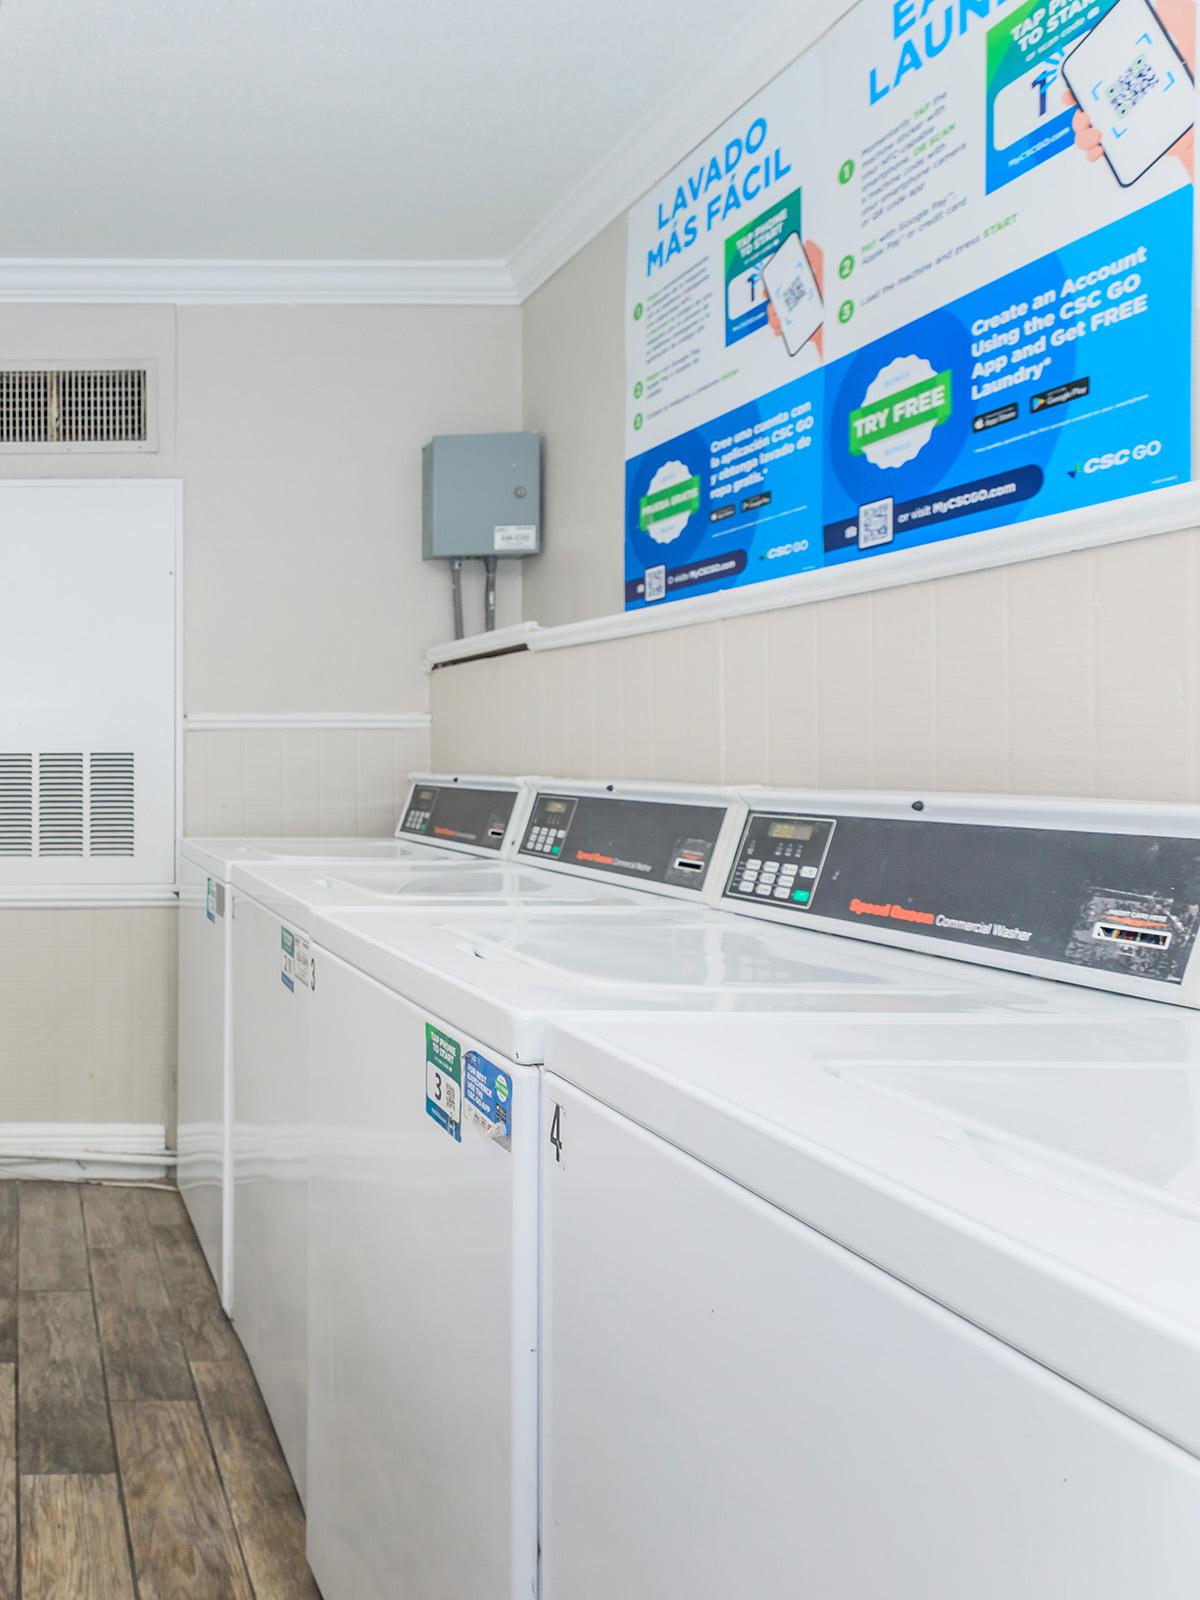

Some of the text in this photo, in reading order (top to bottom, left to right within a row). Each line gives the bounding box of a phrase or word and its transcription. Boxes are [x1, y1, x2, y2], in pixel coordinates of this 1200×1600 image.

[1010, 7, 1046, 41] TAP
[1017, 26, 1044, 52] TO
[1047, 0, 1096, 33] STAR
[869, 0, 1008, 106] LAUN
[658, 117, 768, 231] LAVADO
[647, 147, 793, 278] MÁS FÁCIL
[983, 212, 1018, 239] START
[971, 246, 1147, 336] Create an Account
[971, 274, 1142, 358] Using the CSC GO
[971, 293, 1148, 380] App and Get FREE
[710, 401, 812, 453] Cree una cuenta con
[771, 423, 795, 443] CSC
[795, 415, 815, 433] GO
[853, 384, 946, 438] TRY FREE
[759, 443, 796, 465] lavado
[796, 435, 813, 450] de
[1083, 439, 1163, 475] CSC GO
[897, 482, 1017, 524] or visit MyCSCGO.com
[766, 539, 810, 560] CSC GO
[849, 898, 1032, 942] Speed Queen Commercial Washer
[1130, 911, 1150, 920] CARD
[434, 1072, 442, 1101] 3
[550, 1103, 563, 1163] 4
